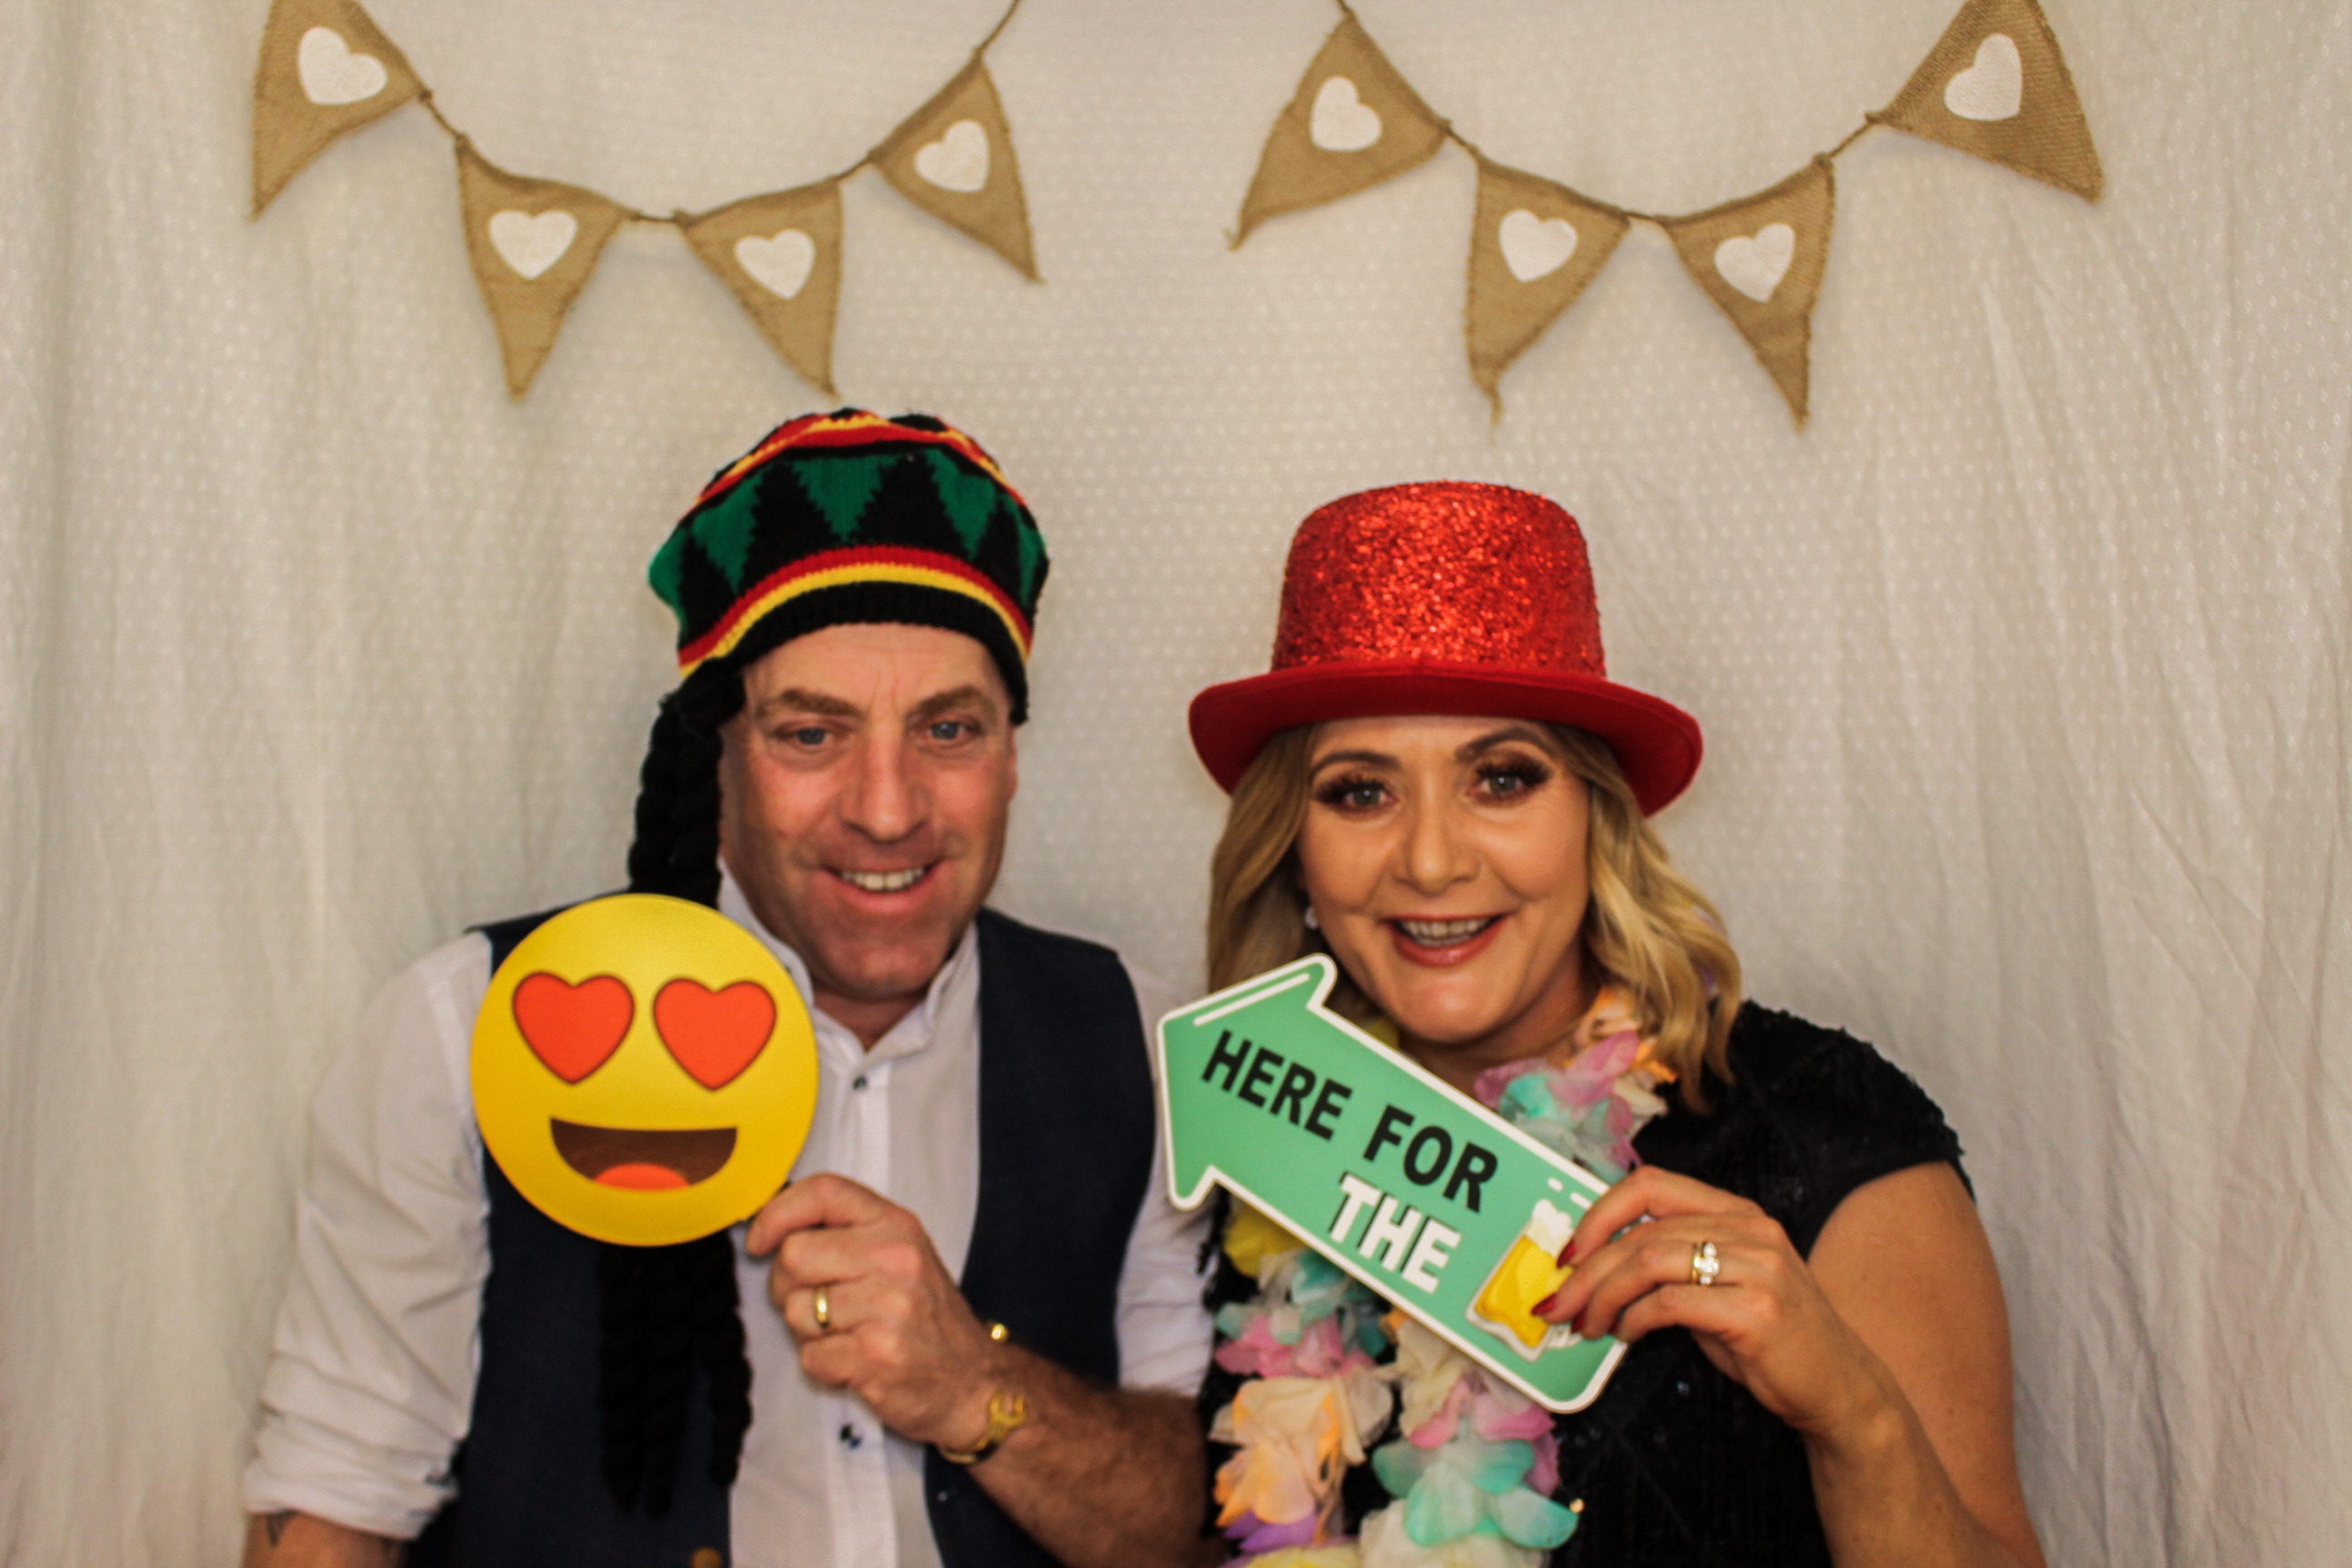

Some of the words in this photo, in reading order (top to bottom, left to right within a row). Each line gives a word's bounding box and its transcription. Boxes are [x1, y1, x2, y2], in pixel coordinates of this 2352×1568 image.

[1201, 1029, 1353, 1141] HERE
[1363, 1104, 1499, 1213] FOR
[1328, 1171, 1462, 1294] THE
